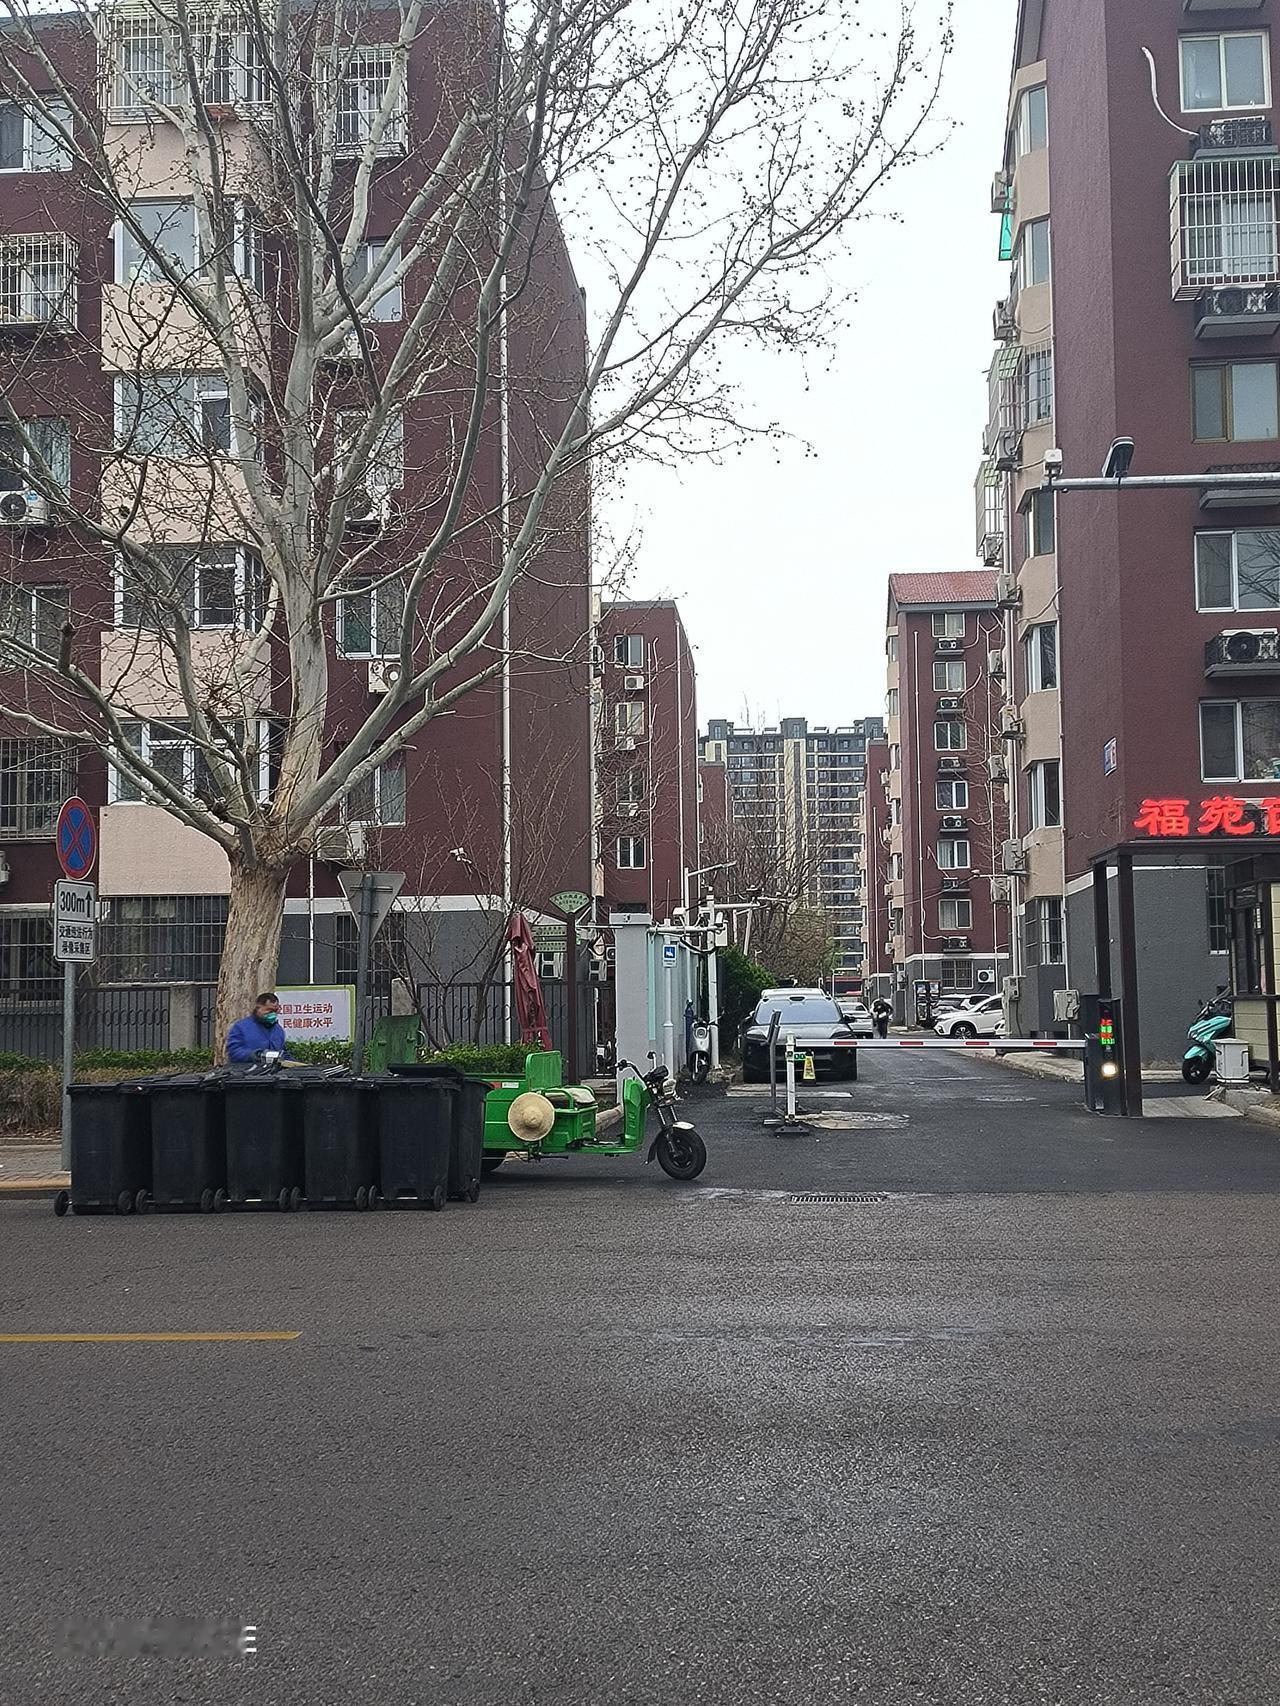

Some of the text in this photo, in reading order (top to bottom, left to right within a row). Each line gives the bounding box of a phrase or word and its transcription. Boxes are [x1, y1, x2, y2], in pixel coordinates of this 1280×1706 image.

[60, 890, 85, 912] 300m
[283, 1017, 333, 1029] 民健康水平
